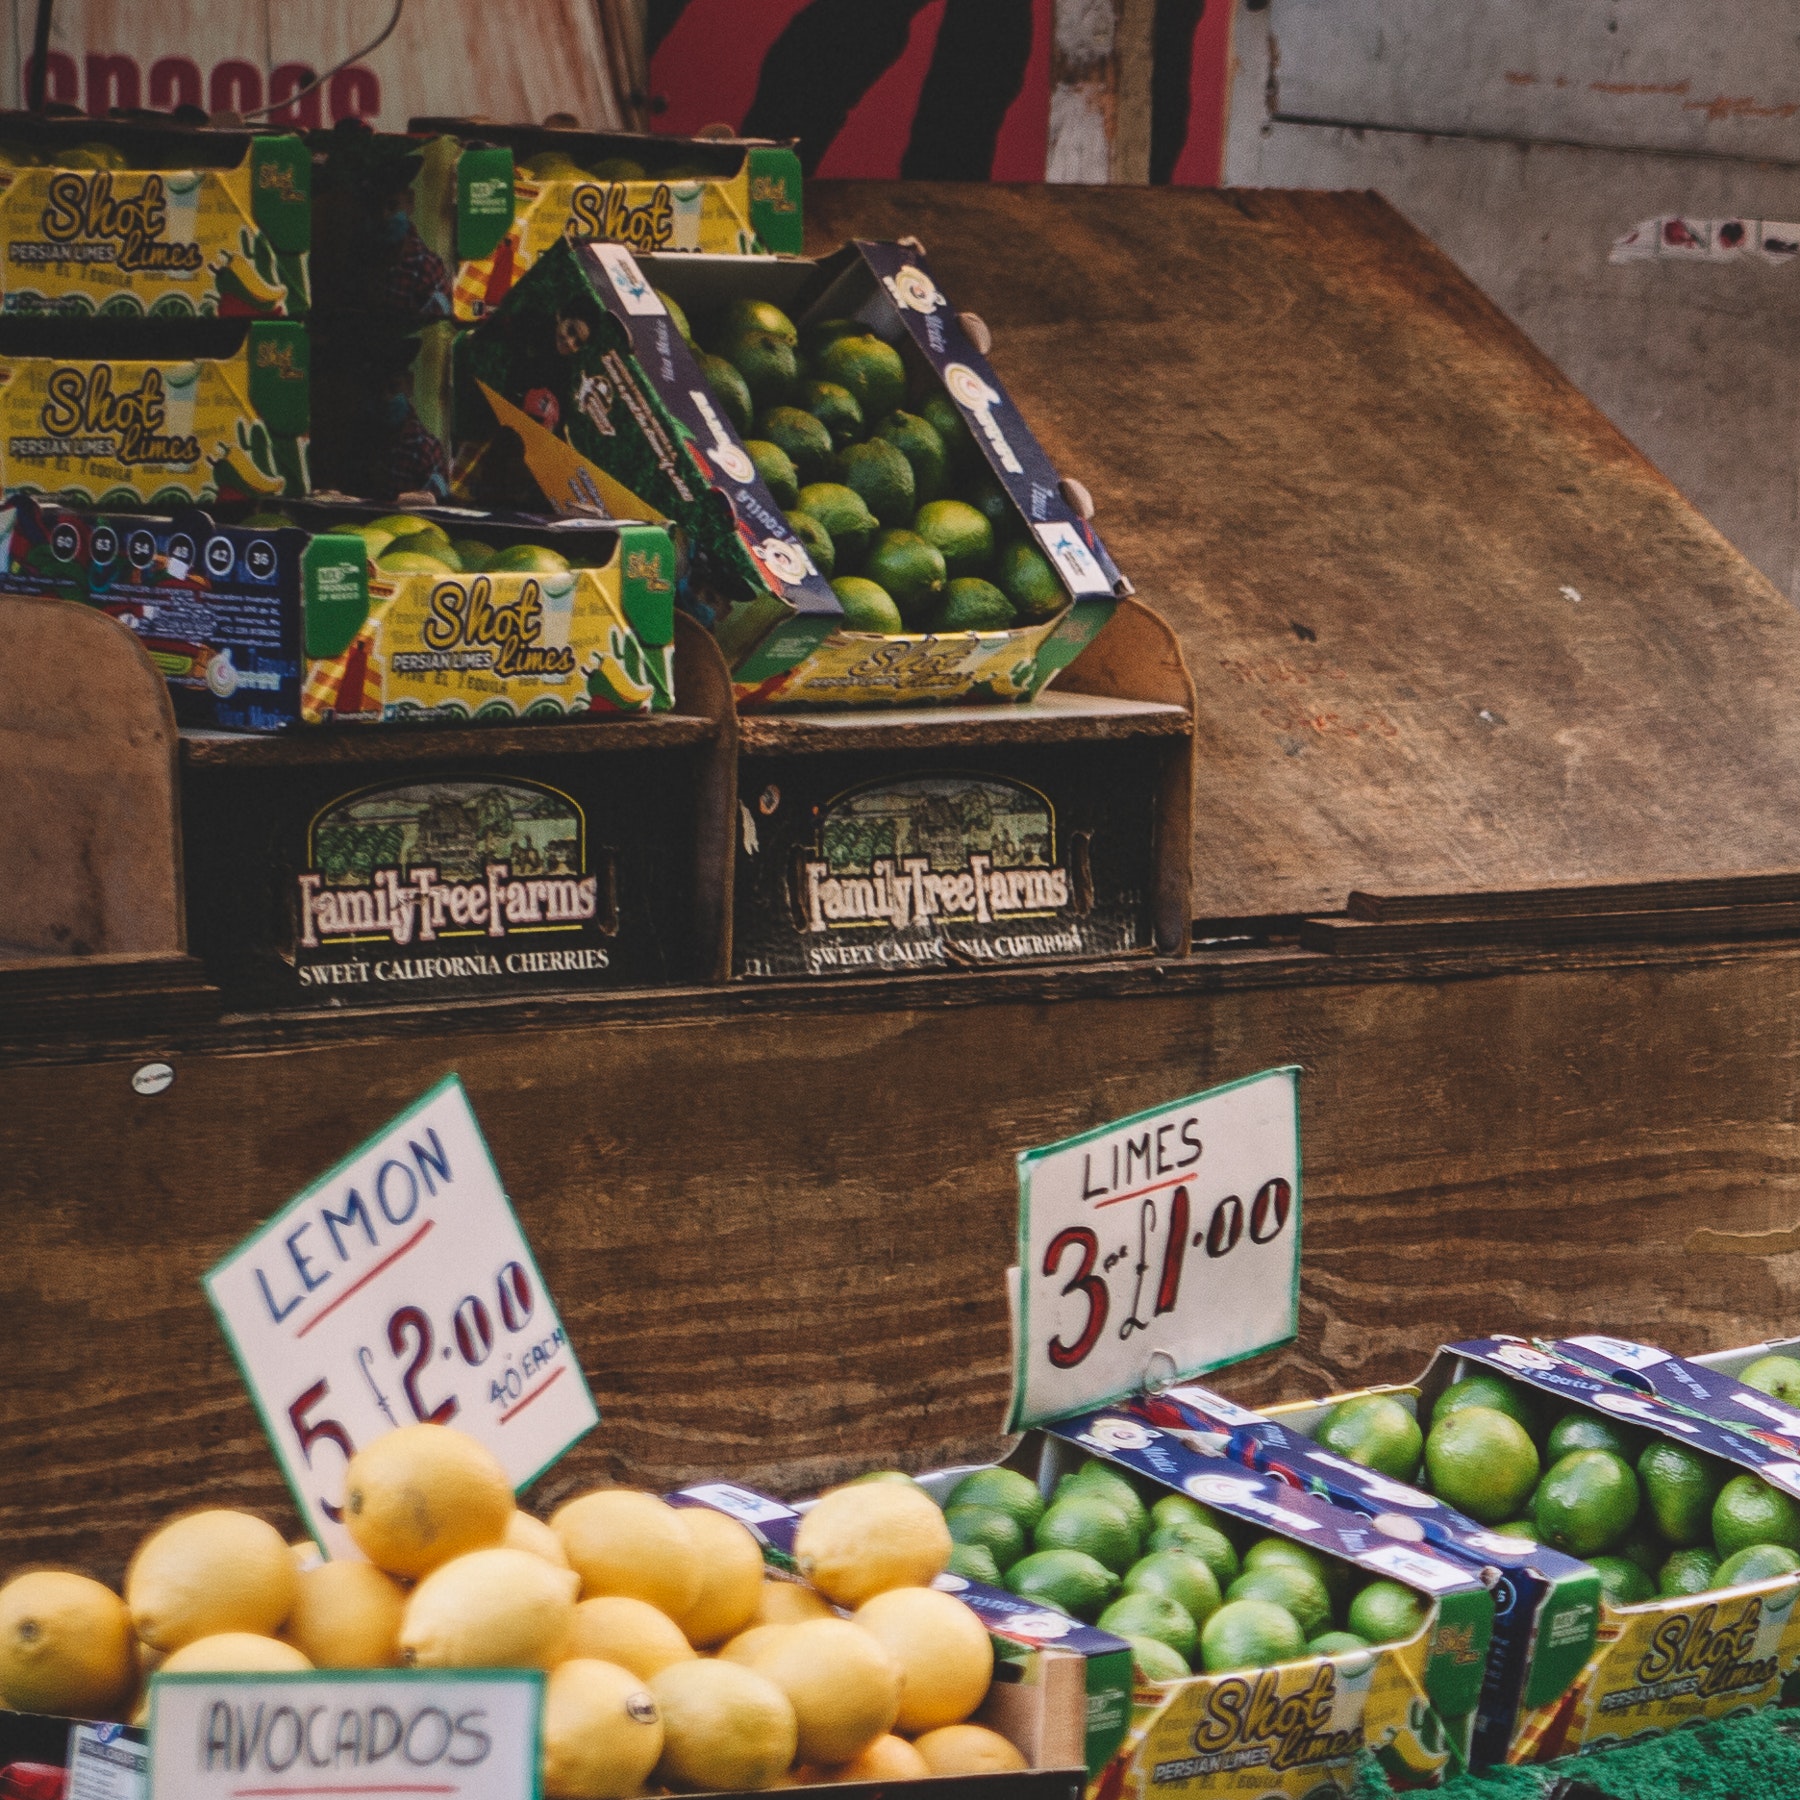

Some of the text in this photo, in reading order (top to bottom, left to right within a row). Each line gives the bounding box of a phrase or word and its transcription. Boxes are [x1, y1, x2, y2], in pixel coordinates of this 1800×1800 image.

[42, 168, 166, 242] Shot
[565, 182, 673, 241] Shot
[10, 243, 116, 262] PERSIAN LIMES
[41, 362, 164, 437] Shot
[10, 437, 116, 456] PERSIAN LIMES
[212, 550, 228, 563] 42
[424, 575, 542, 650] Shot
[393, 650, 493, 672] PERSIAN LIMES
[299, 948, 610, 988] SWEET CALIFORNIA CHERRIES
[809, 944, 875, 968] SWEET
[1082, 1117, 1203, 1201] LIMES
[254, 1127, 453, 1324] LEMON
[1042, 1225, 1110, 1369] 3
[1118, 1176, 1292, 1341] £1.00
[288, 1376, 358, 1524] 5
[1636, 1596, 1762, 1684] Shot
[201, 1699, 492, 1774] AVOCADOS
[1195, 1661, 1337, 1755] Shot
[1154, 1747, 1270, 1783] PERSIAN LIMES
